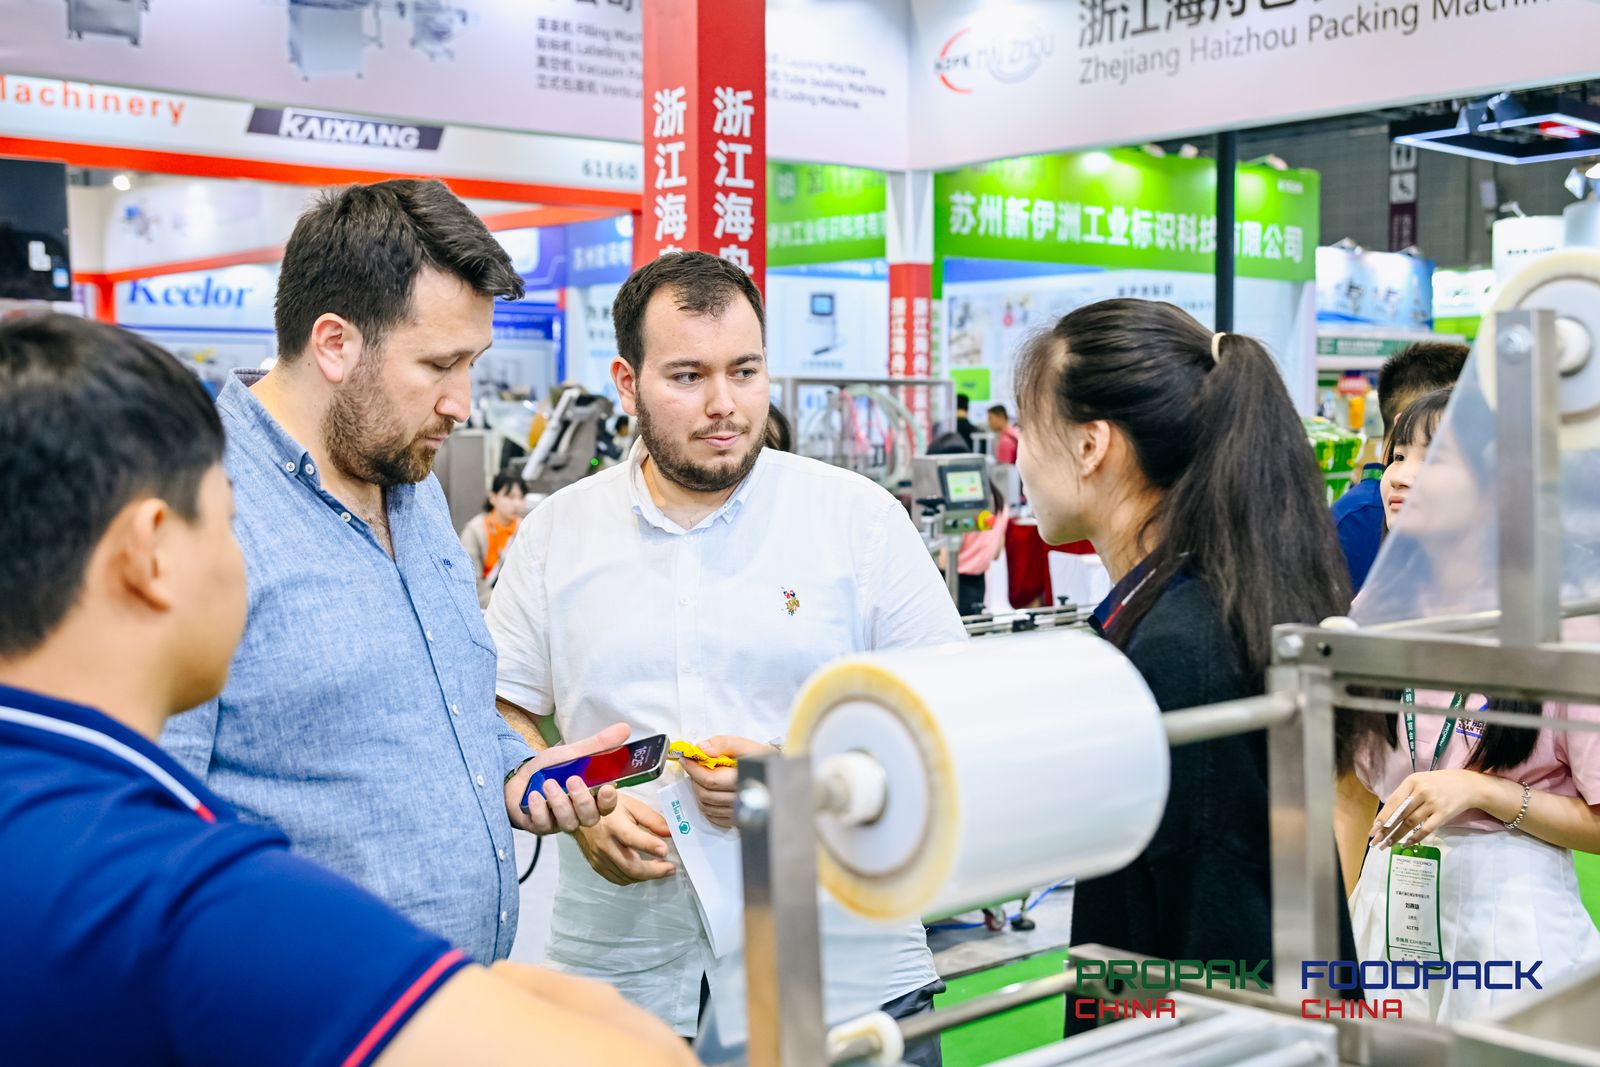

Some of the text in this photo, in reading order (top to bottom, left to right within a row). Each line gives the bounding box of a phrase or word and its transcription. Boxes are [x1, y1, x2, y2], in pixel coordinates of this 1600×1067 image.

[1079, 48, 1180, 85] Zhejiang
[1189, 26, 1297, 63] Haizhou
[1307, 4, 1419, 42] Packing
[279, 107, 421, 149] KAIXIANG
[653, 86, 688, 257] 浙江海
